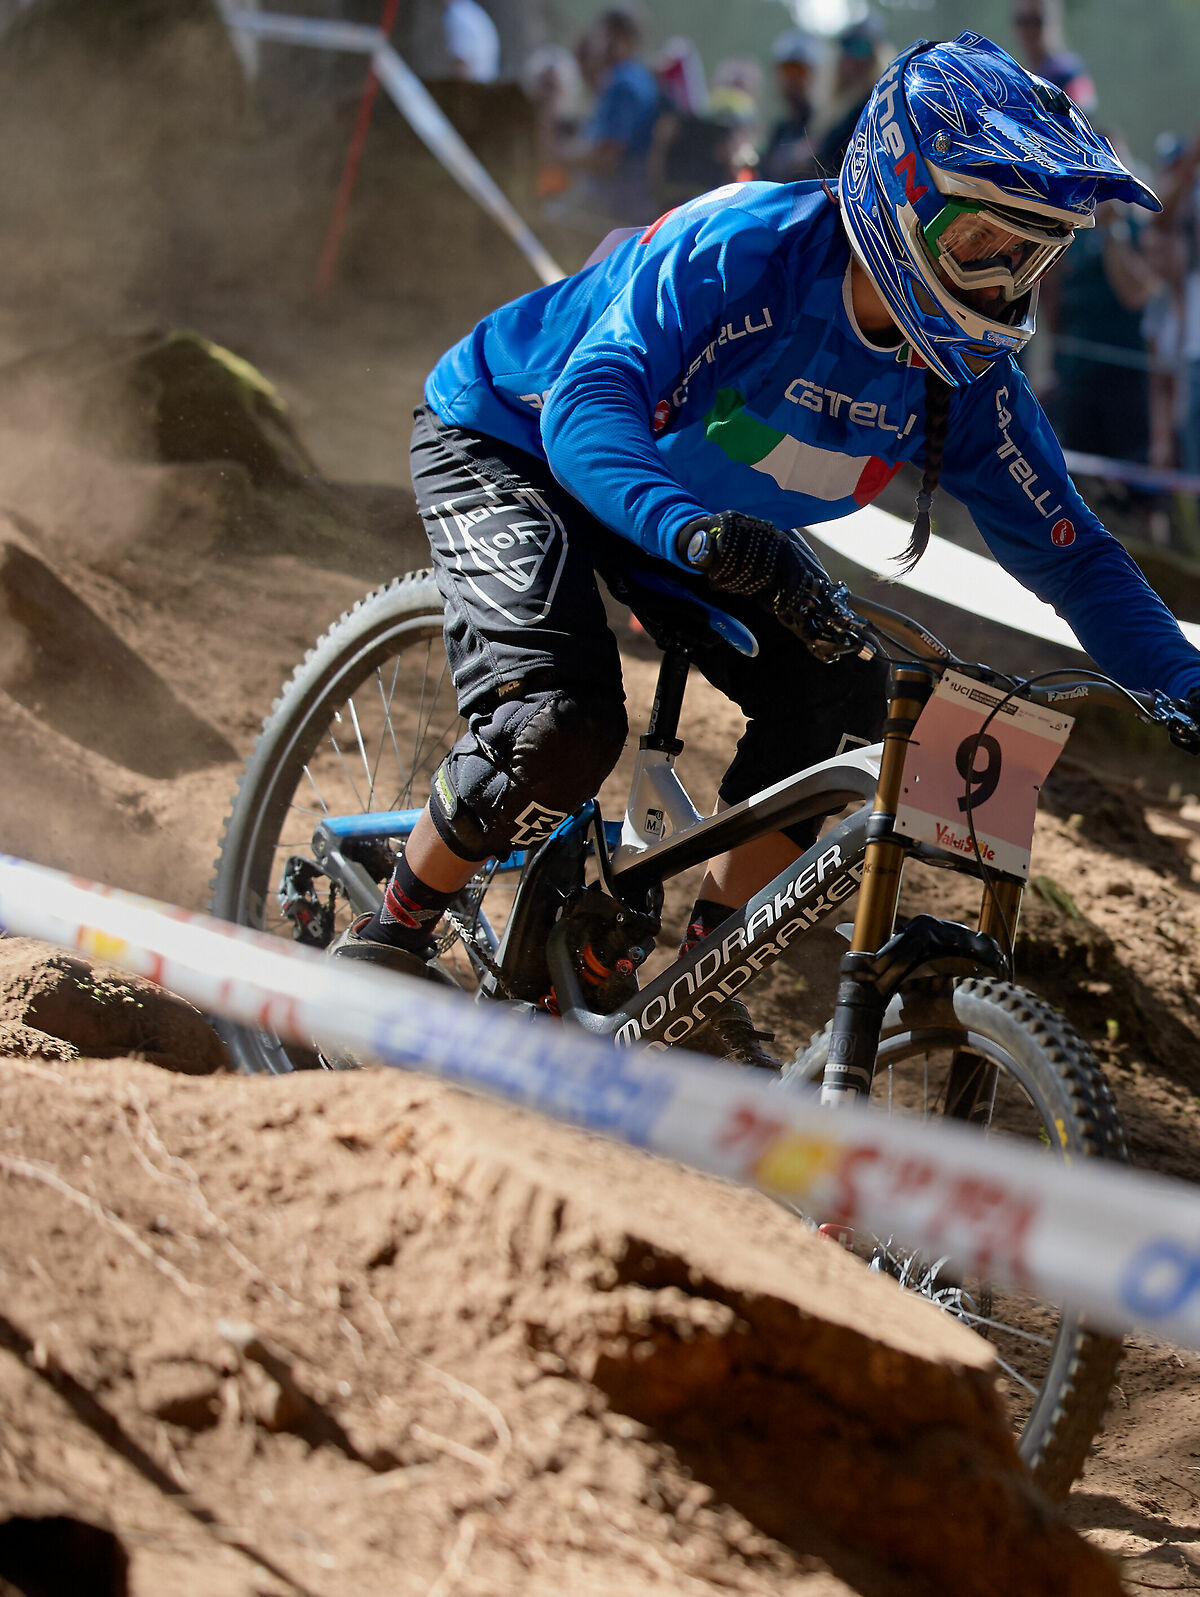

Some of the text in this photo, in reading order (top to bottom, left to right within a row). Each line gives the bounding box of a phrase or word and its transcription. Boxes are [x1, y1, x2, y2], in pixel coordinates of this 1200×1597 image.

[952, 682, 970, 697] UCI
[955, 733, 1002, 812] 9
[935, 822, 954, 847] Val
[614, 844, 842, 1049] MONDRAKER
